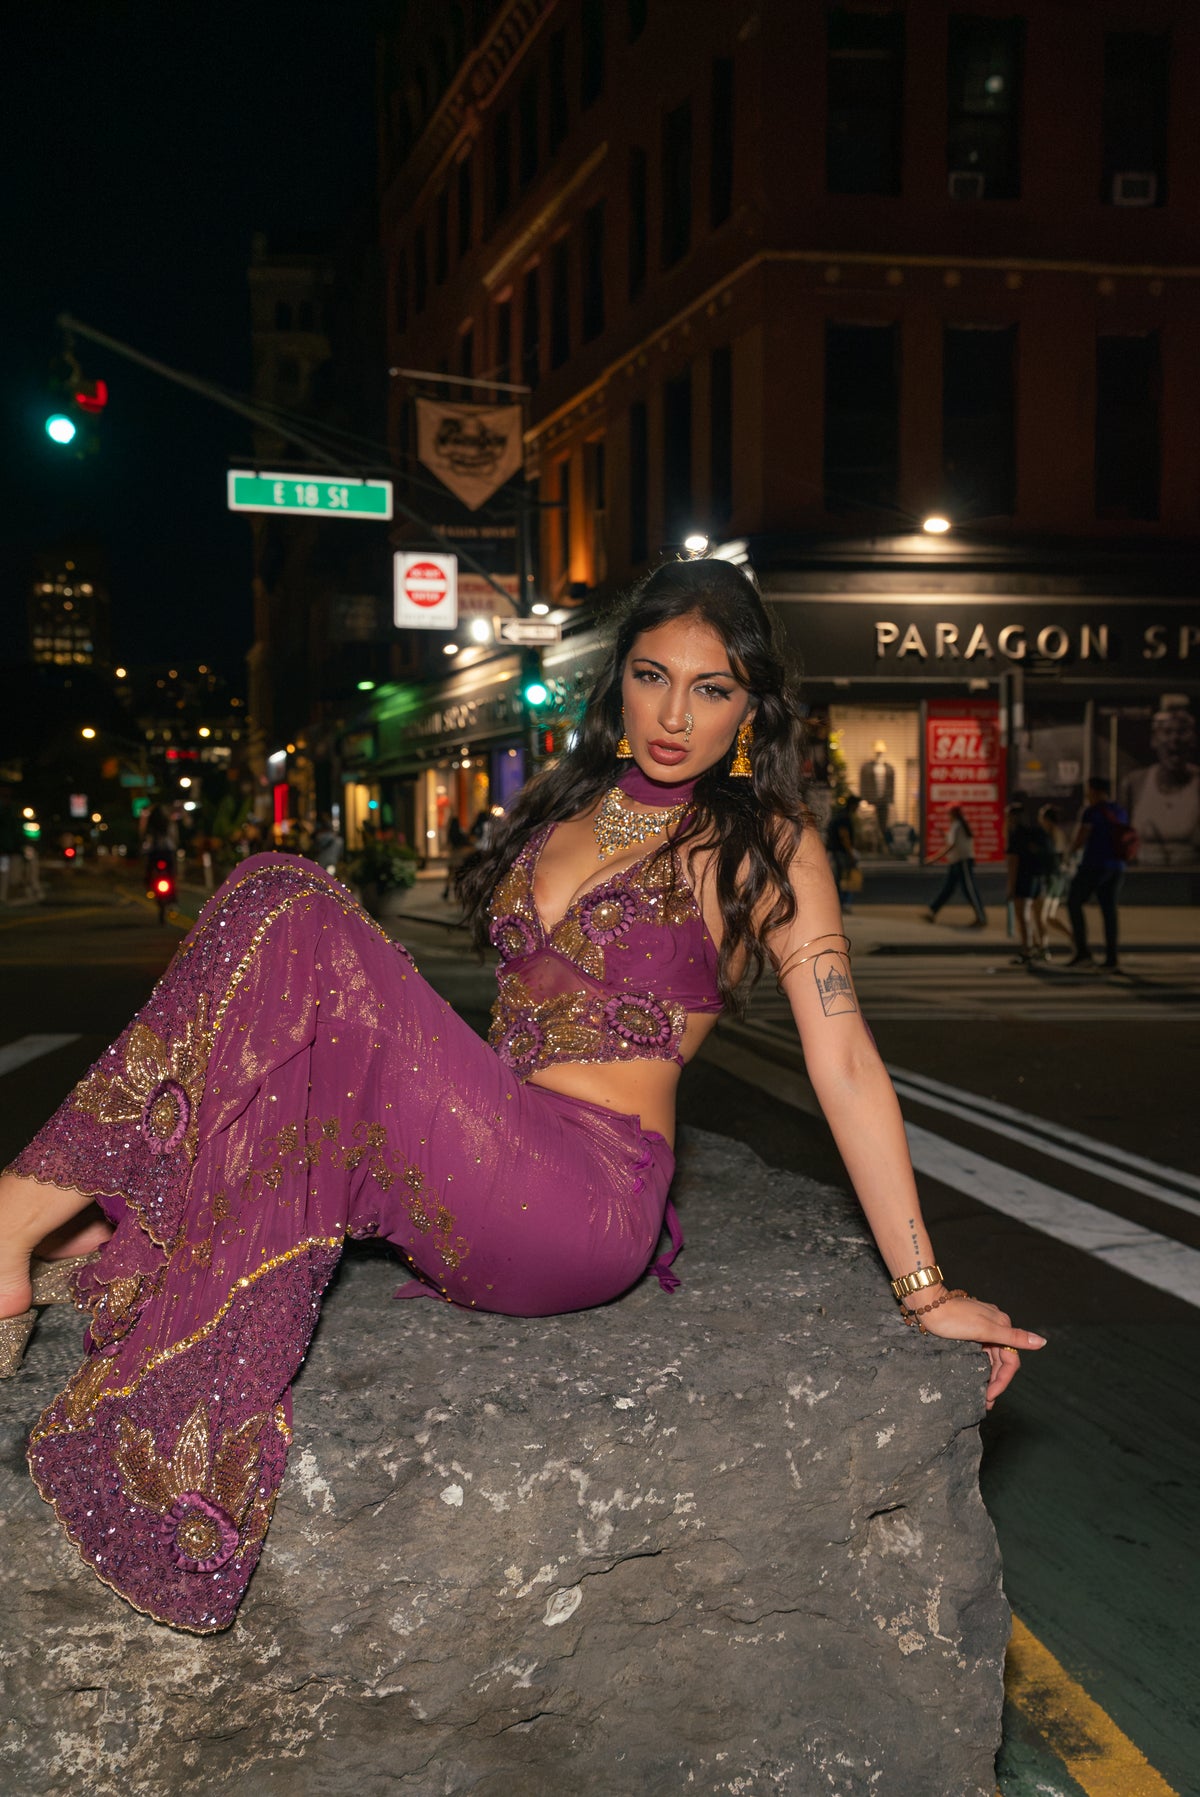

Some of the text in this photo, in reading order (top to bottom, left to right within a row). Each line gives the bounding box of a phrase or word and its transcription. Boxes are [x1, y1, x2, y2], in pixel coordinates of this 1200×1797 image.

[273, 482, 349, 509] E 18 St
[875, 621, 1109, 660] PARAGON
[936, 736, 995, 760] SALE
